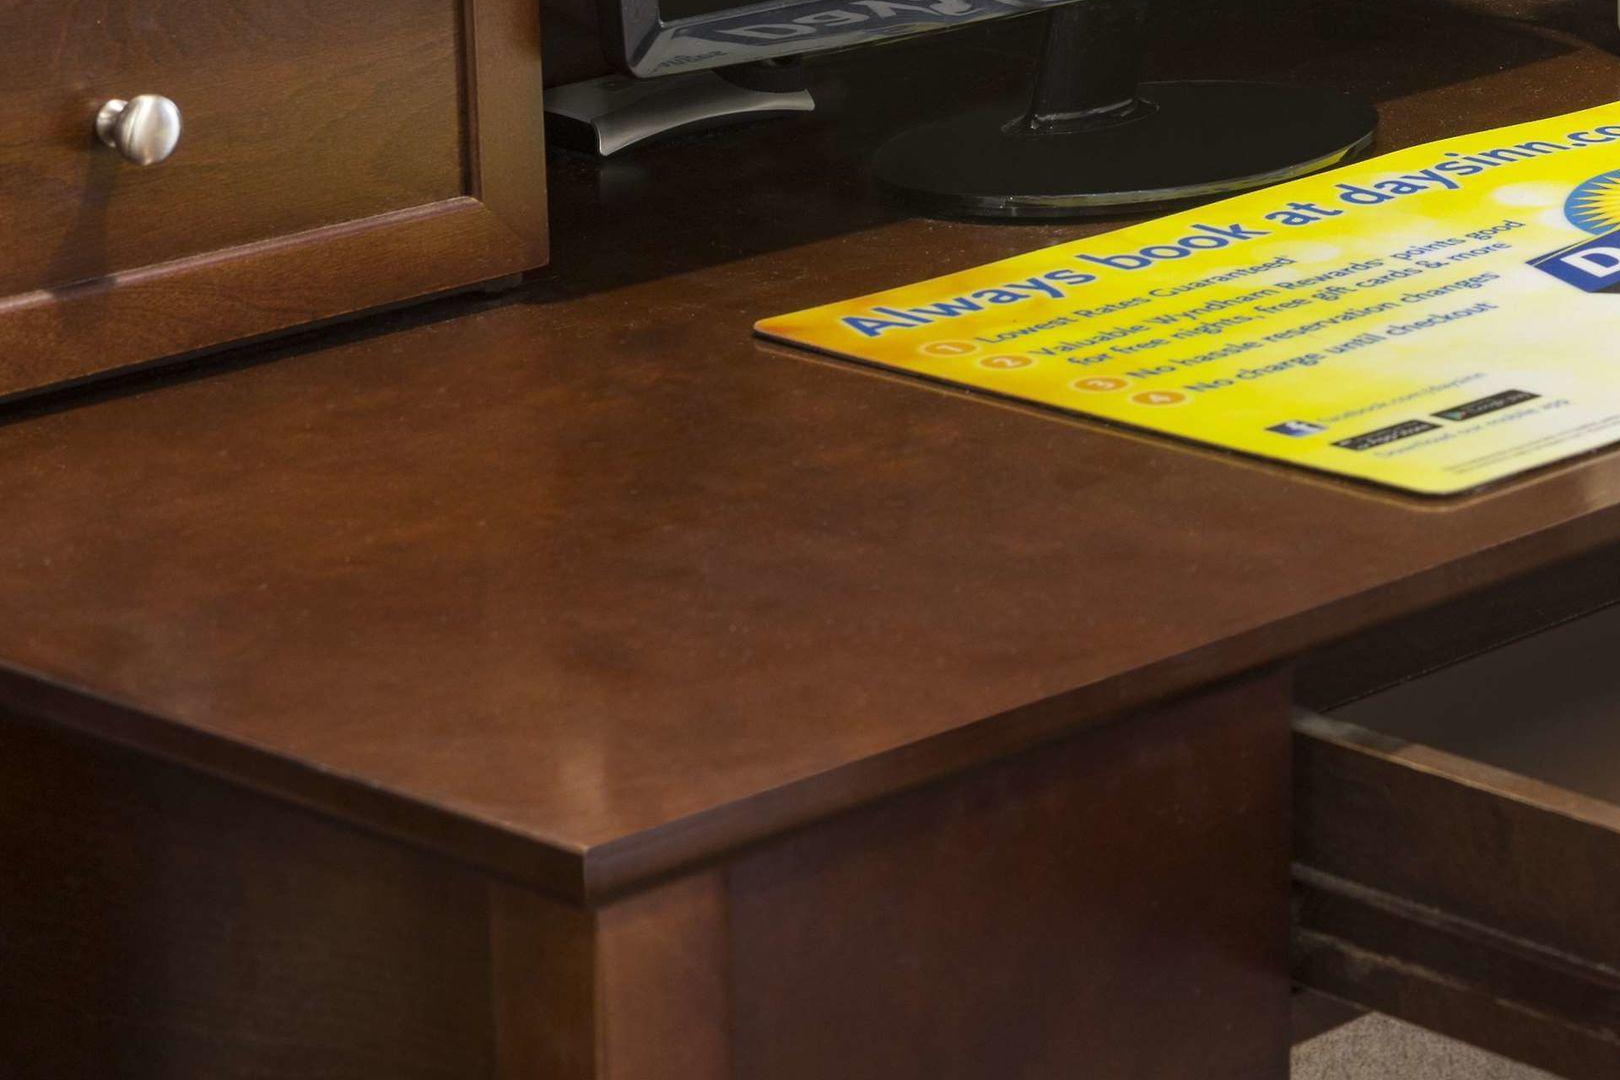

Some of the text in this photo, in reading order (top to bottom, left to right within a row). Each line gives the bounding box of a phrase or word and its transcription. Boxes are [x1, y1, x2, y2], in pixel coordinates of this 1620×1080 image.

[841, 269, 1096, 337] Always
[1075, 223, 1271, 270] book
[1265, 202, 1343, 226] at
[976, 257, 1296, 343] Lowest Rates Guaranteed
[1030, 220, 1525, 355] Valuable Wyndham Rewards points good
[1067, 353, 1113, 366] for
[1109, 339, 1170, 354] free
[1171, 316, 1264, 339] nights,
[1254, 299, 1312, 313] free
[1312, 286, 1356, 301] gift
[1355, 268, 1423, 287] cards
[1448, 244, 1511, 261] more
[1126, 273, 1500, 378] No hassle reservation changes
[1184, 303, 1497, 392] No charge until checkout
